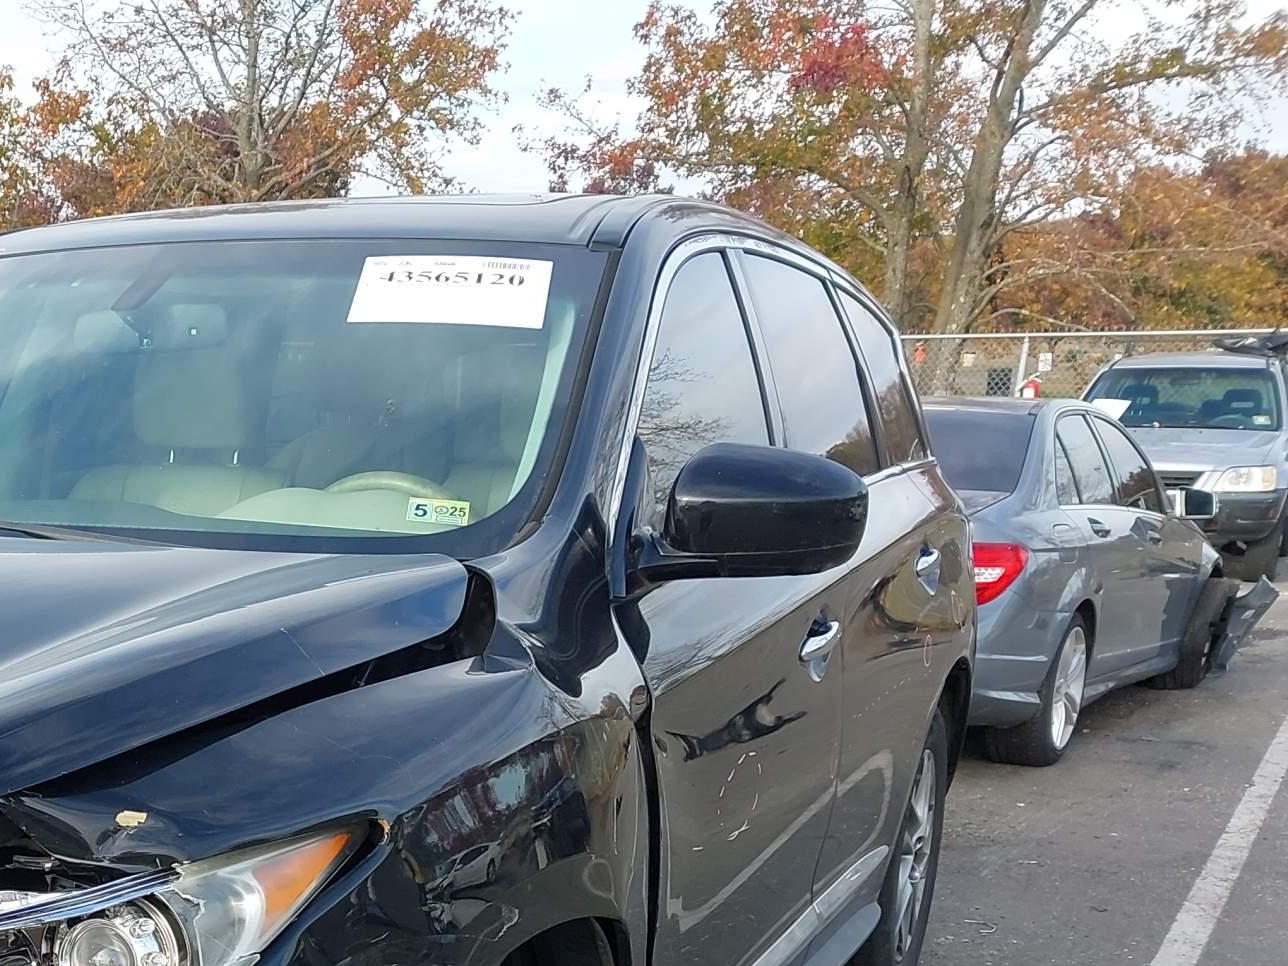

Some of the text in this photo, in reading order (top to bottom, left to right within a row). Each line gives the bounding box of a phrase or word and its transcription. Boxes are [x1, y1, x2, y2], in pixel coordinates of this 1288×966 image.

[379, 271, 525, 287] 43565120
[413, 504, 466, 517] 5 25
